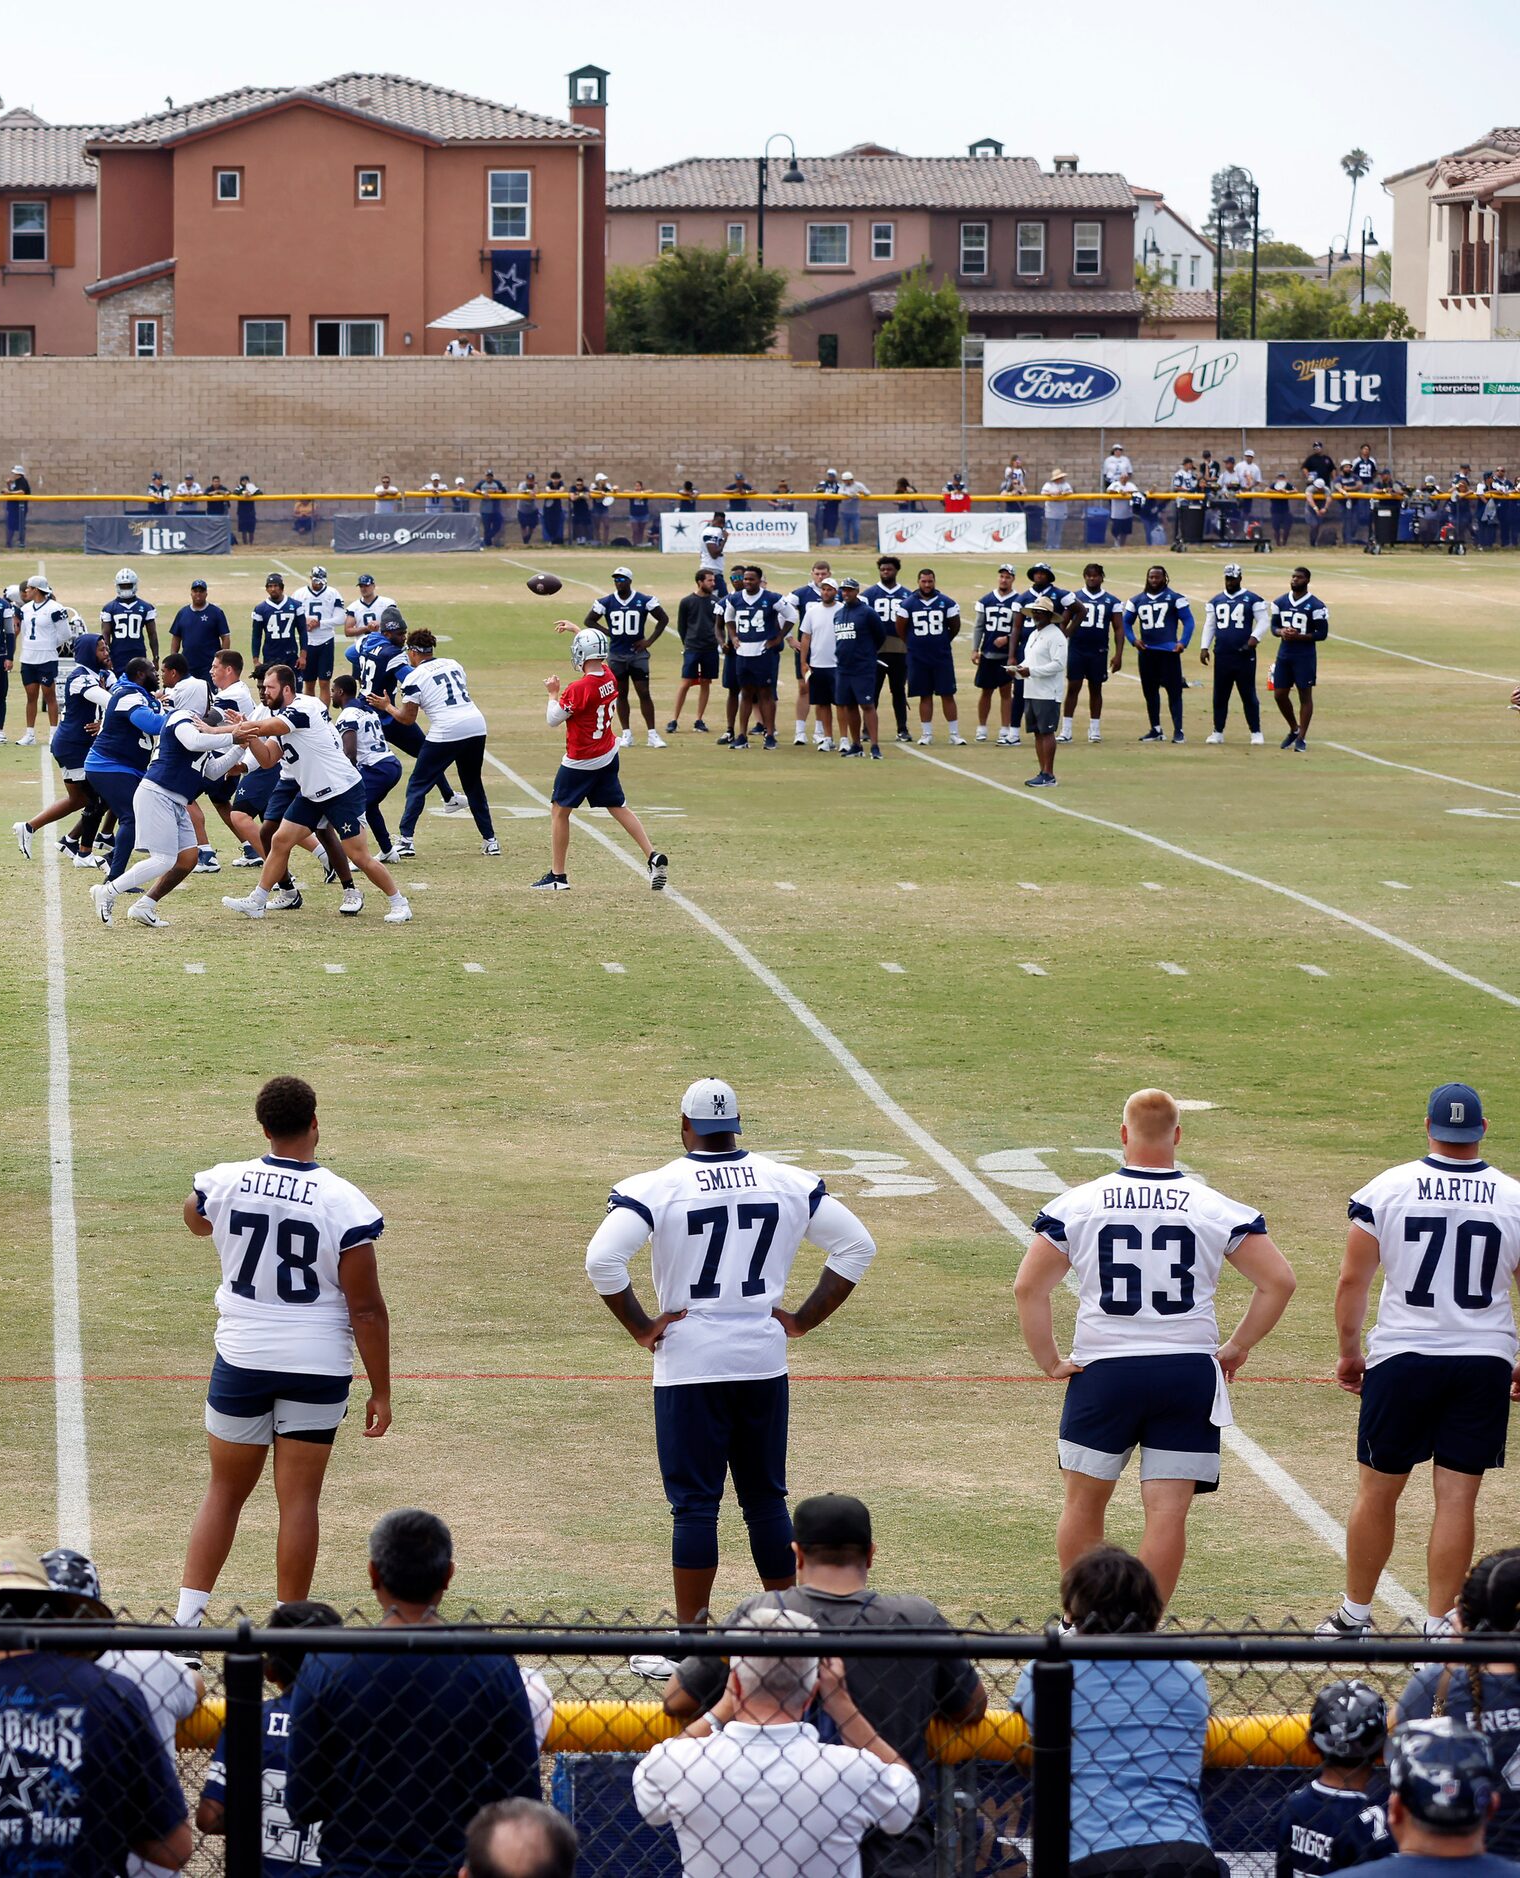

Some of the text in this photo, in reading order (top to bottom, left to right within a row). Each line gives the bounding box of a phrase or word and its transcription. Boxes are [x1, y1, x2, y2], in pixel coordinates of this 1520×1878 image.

[1014, 365, 1095, 400] Ford
[1292, 357, 1340, 382] Miller
[1153, 344, 1239, 423] 7UP
[1310, 369, 1381, 412] Lite
[140, 527, 186, 554] Lite
[359, 530, 456, 542] sleep number
[724, 519, 798, 535] Academy
[309, 602, 323, 622] 5
[609, 610, 640, 636] 90
[735, 610, 765, 633] 54
[912, 610, 944, 637] 58
[985, 606, 1013, 633] 52
[1137, 602, 1169, 629] 97
[1215, 603, 1245, 629] 94
[1280, 613, 1308, 636] 59
[29, 617, 36, 640] 1
[114, 614, 143, 640] 50
[266, 613, 295, 639] 47
[1449, 1102, 1465, 1124] D
[240, 1171, 317, 1205] STEELE
[696, 1165, 758, 1192] SMITH
[1416, 1177, 1497, 1204] MARTIN
[1102, 1186, 1190, 1213] BIADASZ
[230, 1209, 320, 1303] 78
[686, 1202, 779, 1299] 77
[1404, 1216, 1502, 1309] 70
[1098, 1224, 1196, 1316] 63
[1358, 1805, 1389, 1841] 7
